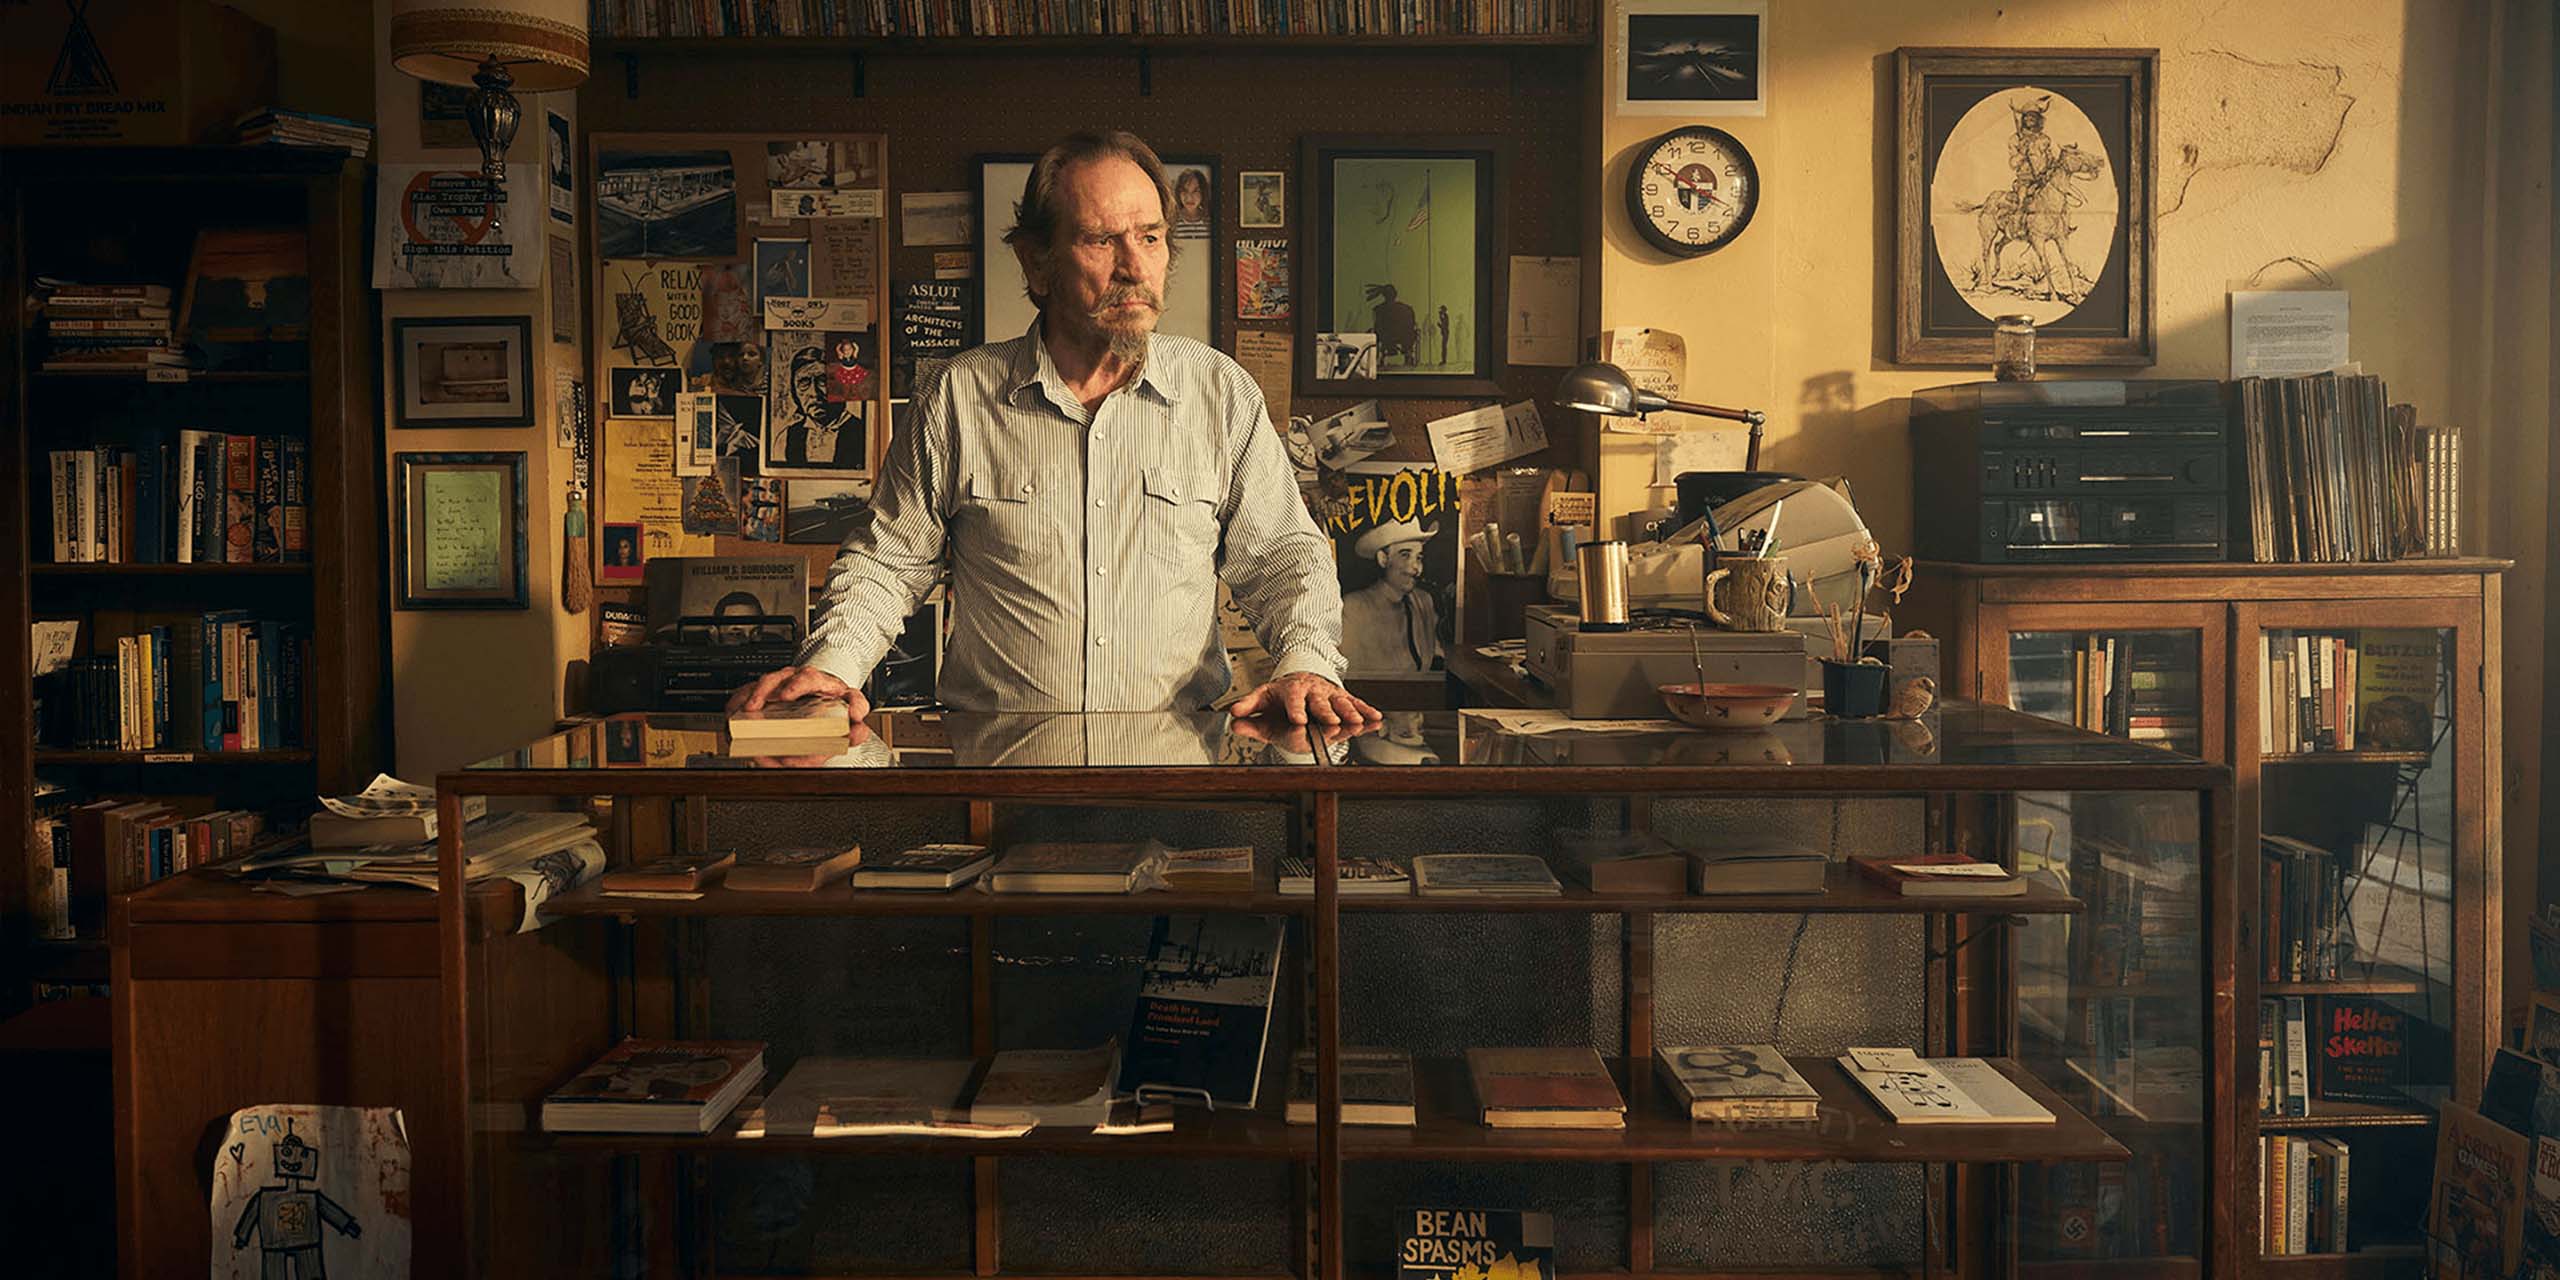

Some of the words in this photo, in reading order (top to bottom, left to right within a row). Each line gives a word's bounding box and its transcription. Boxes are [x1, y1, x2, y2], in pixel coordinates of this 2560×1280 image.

[1, 102, 52, 116] INDIAN
[86, 101, 135, 115] BREAD
[137, 101, 166, 113] MIX
[1667, 147, 1682, 159] 11
[1687, 141, 1706, 154] 12
[1713, 148, 1721, 160] 1
[1724, 165, 1738, 177] 2
[1645, 183, 1658, 196] 9
[441, 192, 478, 203] Trophy
[462, 206, 487, 215] Park
[1651, 205, 1665, 218] 8
[1722, 207, 1735, 218] 4
[1667, 220, 1680, 234] 7
[1687, 227, 1700, 240] 6
[1707, 221, 1721, 234] 5
[404, 244, 429, 255] Sign
[433, 244, 454, 254] this
[461, 244, 512, 254] Petition
[660, 269, 703, 291] RELAX
[667, 292, 687, 302] WITH
[689, 292, 697, 301] A
[669, 303, 701, 321] GOOD
[783, 319, 815, 328] BOOKS
[903, 313, 963, 331] ARCHITECTS
[665, 323, 697, 342] BOOK
[923, 326, 944, 337] THE
[910, 338, 961, 349] MASSACRE
[263, 450, 280, 482] BLACK
[262, 467, 277, 504] MASK
[691, 564, 730, 577] WILLIAM
[741, 563, 795, 575] BURROUGHS
[604, 610, 648, 624] DURACELL
[2333, 1007, 2400, 1033] Helter
[2326, 1035, 2401, 1058] Skelter
[1416, 1209, 1488, 1238] BEAN
[1402, 1237, 1498, 1264] SPASMS
